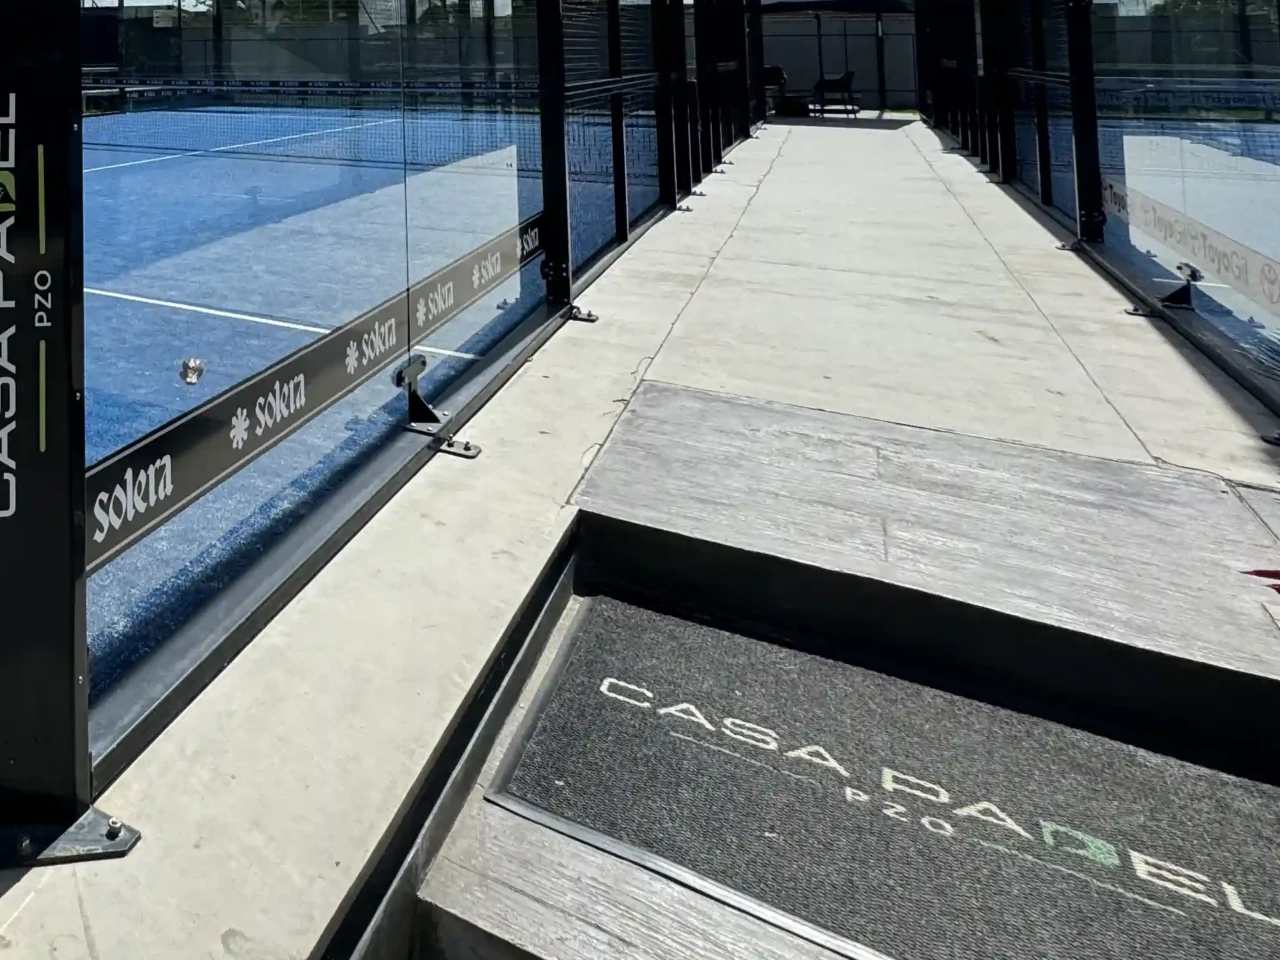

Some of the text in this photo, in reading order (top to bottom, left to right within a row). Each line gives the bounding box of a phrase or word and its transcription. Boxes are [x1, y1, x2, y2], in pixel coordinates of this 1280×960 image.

[34, 270, 52, 327] PZO
[427, 280, 454, 320] solera
[361, 317, 396, 366] solera
[254, 371, 307, 436] solera
[93, 453, 174, 543] solera
[600, 677, 1280, 927] CASA PADEL
[845, 785, 955, 837] PZO
